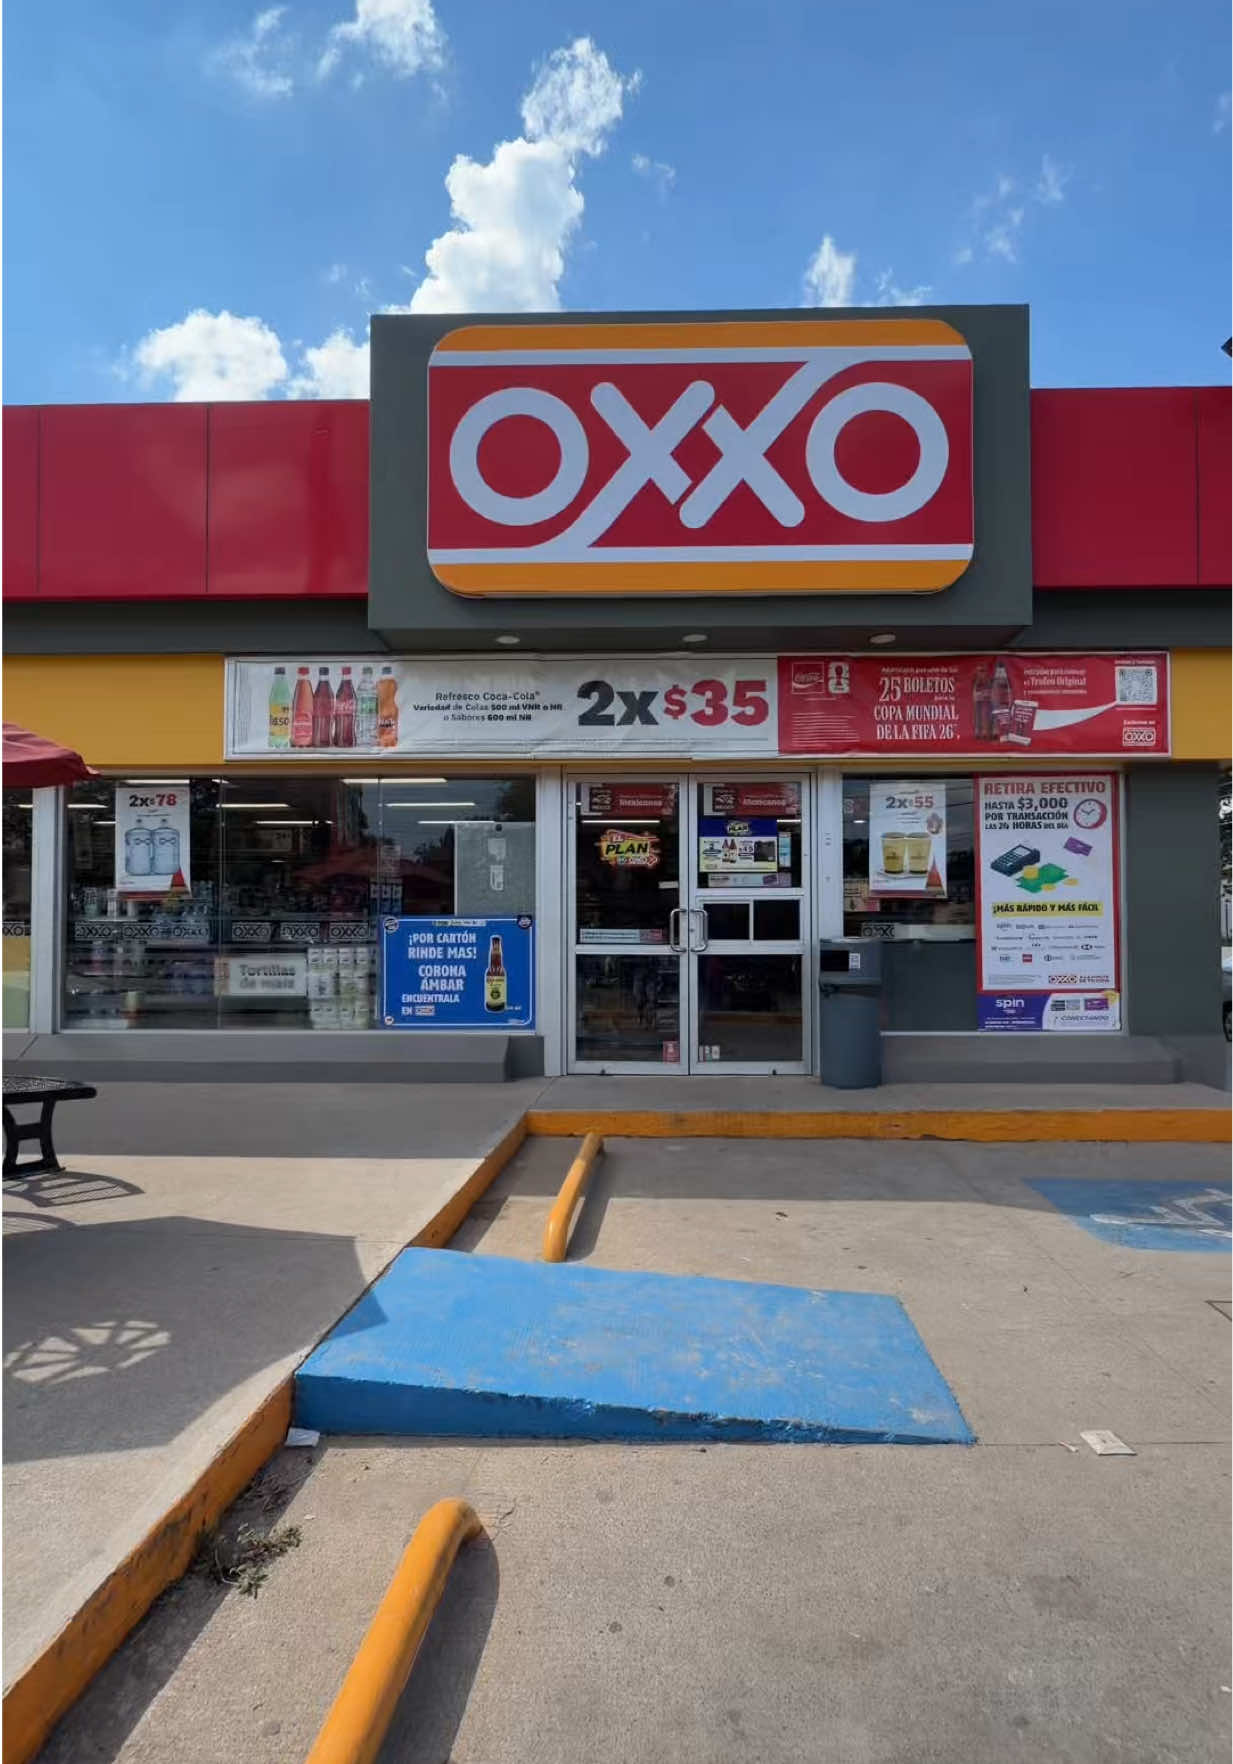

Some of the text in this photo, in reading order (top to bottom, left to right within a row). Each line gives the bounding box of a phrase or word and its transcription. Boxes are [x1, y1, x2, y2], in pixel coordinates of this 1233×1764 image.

[449, 373, 949, 536] OXXO
[879, 677, 955, 701] 25 BOLETOS
[435, 691, 480, 701] Refresco
[452, 703, 463, 711] de
[874, 704, 959, 721] COPA MUNDIAL
[451, 713, 486, 722] Sabores
[876, 724, 894, 740] DE
[894, 724, 910, 740] LA
[911, 724, 936, 740] FIFA
[984, 781, 1106, 795] RETIRA EFECTIVO
[984, 796, 1069, 811] HASTA $3,000
[985, 811, 1069, 821] POR TRANSACCIÓN
[1012, 821, 1042, 830] HORAS
[605, 843, 649, 855] PLAN
[1016, 902, 1048, 912] RÁPIDO
[1049, 904, 1057, 912] Y
[1058, 903, 1076, 912] MÁS
[408, 931, 476, 946] ¡POR CARTÓN
[408, 947, 477, 959] RINDE MAS!
[418, 965, 466, 977] CORONA
[420, 977, 464, 991] ÁMBAR
[401, 993, 460, 1003] ENCUENTRALA
[994, 996, 1025, 1009] spin
[401, 1006, 412, 1015] EN
